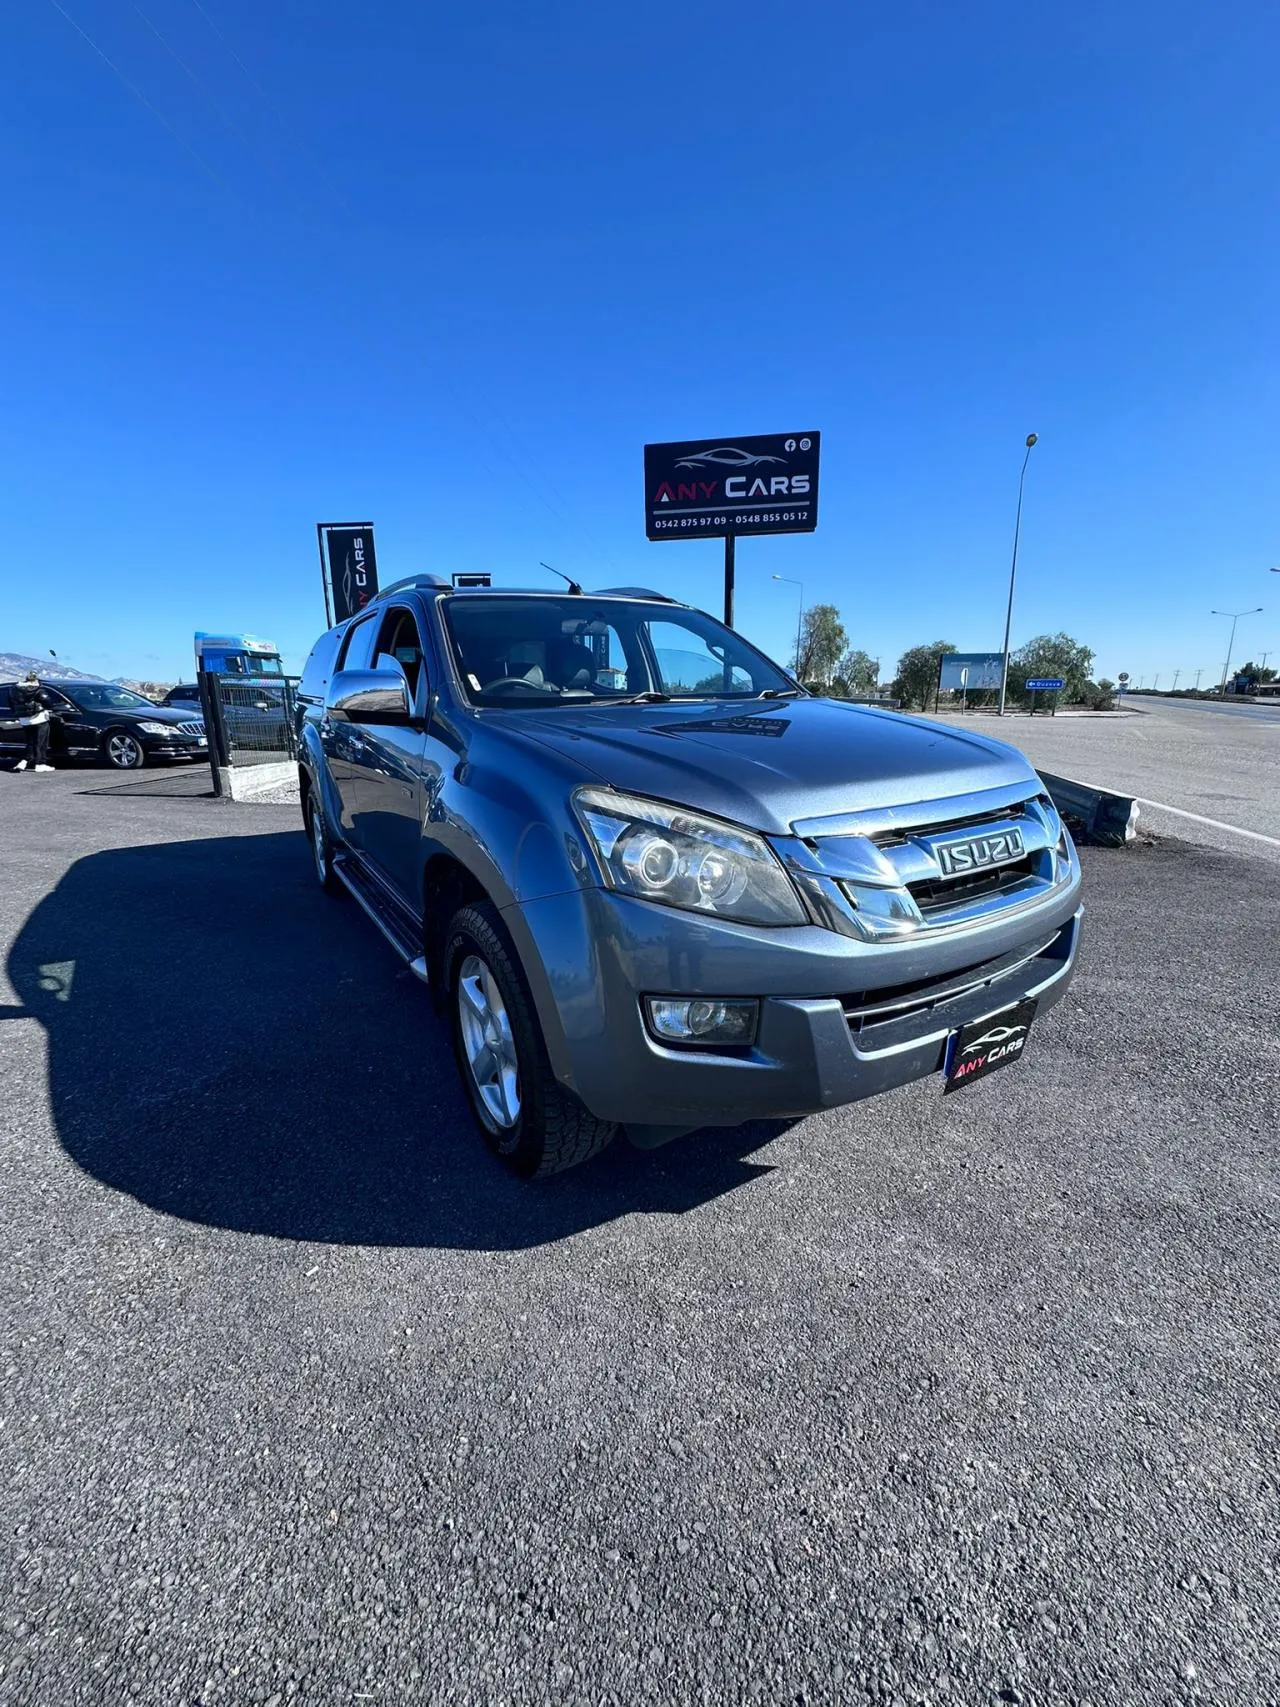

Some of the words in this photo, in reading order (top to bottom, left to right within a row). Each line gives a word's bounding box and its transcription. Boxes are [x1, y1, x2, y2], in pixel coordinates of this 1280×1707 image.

[653, 480, 717, 502] ANY
[725, 475, 810, 498] CARS
[655, 519, 679, 528] 0542
[681, 518, 698, 526] 875
[700, 517, 711, 526] 97
[714, 516, 727, 525] 09
[735, 514, 761, 524] 0548
[763, 513, 780, 522] 855
[783, 512, 795, 521] 05
[798, 511, 808, 520] 12
[353, 537, 367, 586] CARS
[941, 832, 1023, 873] ISUZU
[954, 1055, 987, 1079] ANY
[987, 1037, 1024, 1063] CARS
